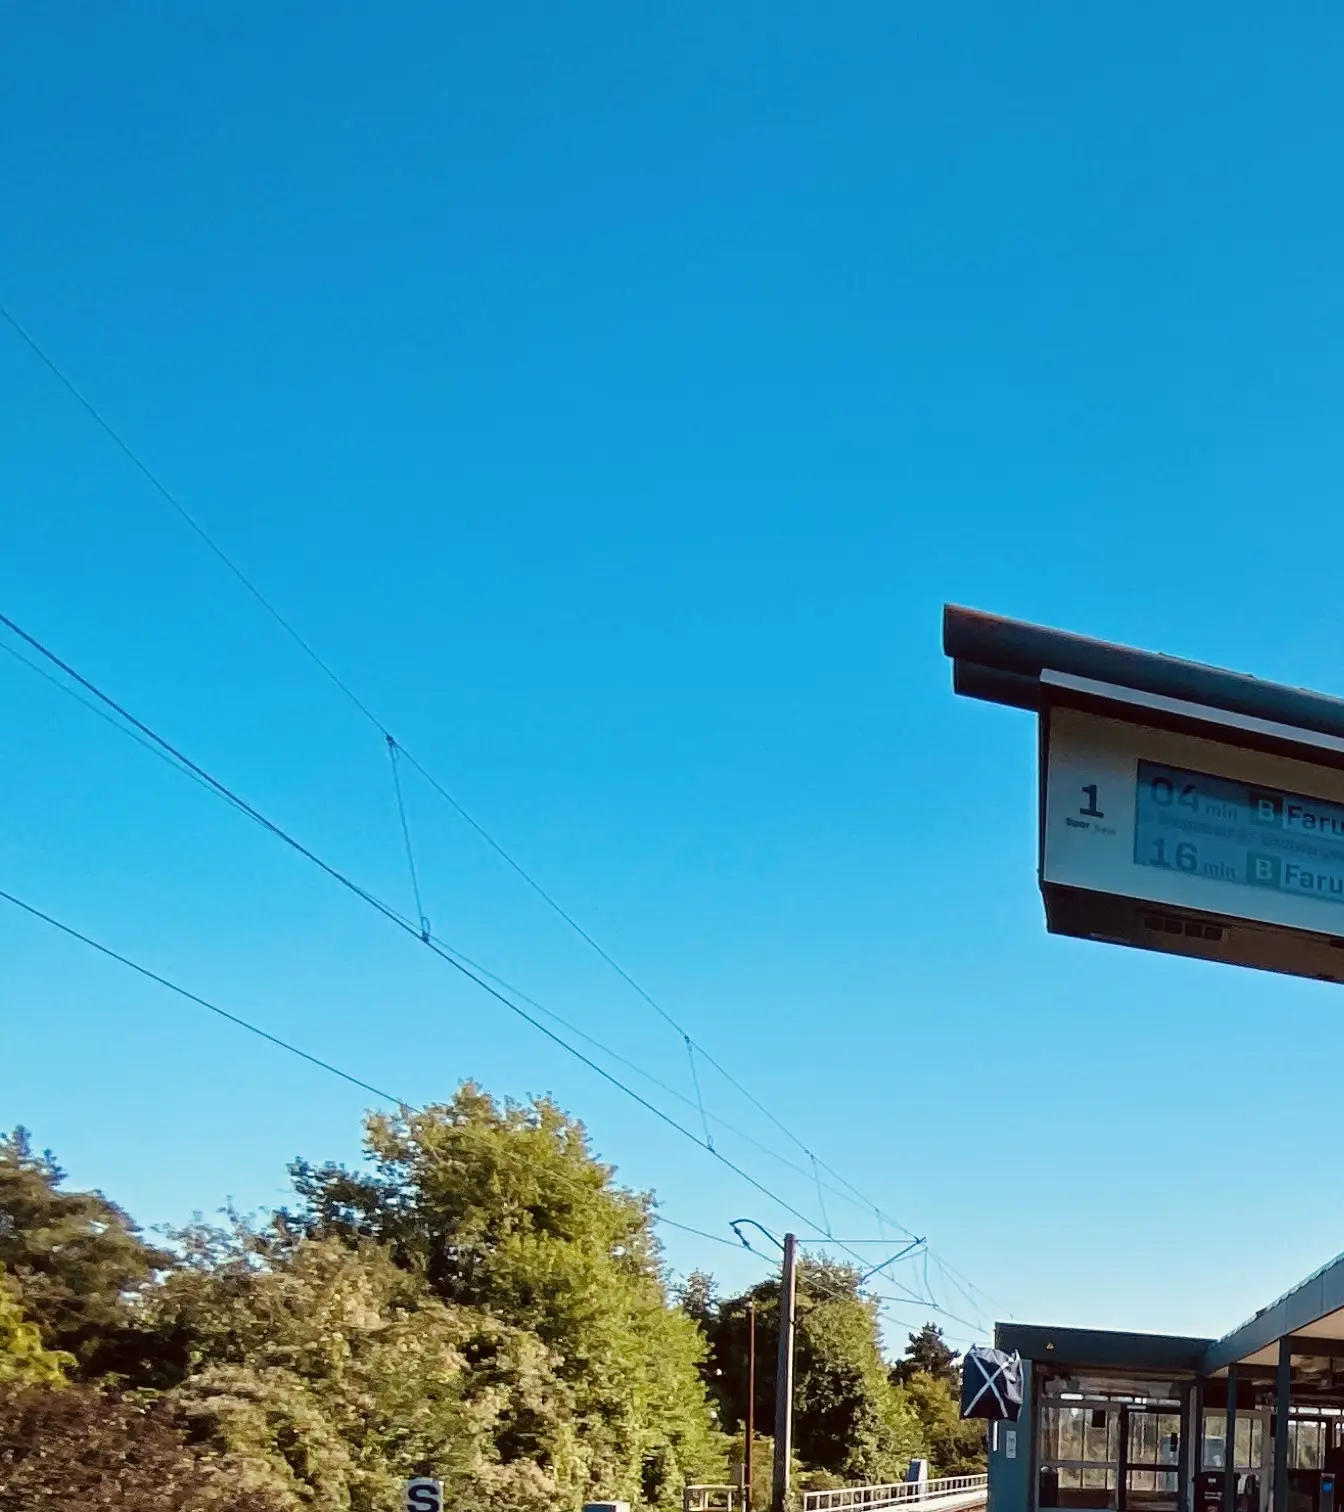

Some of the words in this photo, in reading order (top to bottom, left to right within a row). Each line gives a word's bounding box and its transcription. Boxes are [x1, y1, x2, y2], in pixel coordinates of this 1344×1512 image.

[1079, 784, 1105, 818] 1
[1151, 776, 1199, 814] 04
[1206, 804, 1238, 821] min
[1257, 799, 1275, 822] B
[1151, 838, 1198, 872] 16
[1203, 861, 1238, 880] min
[1255, 858, 1273, 880] B
